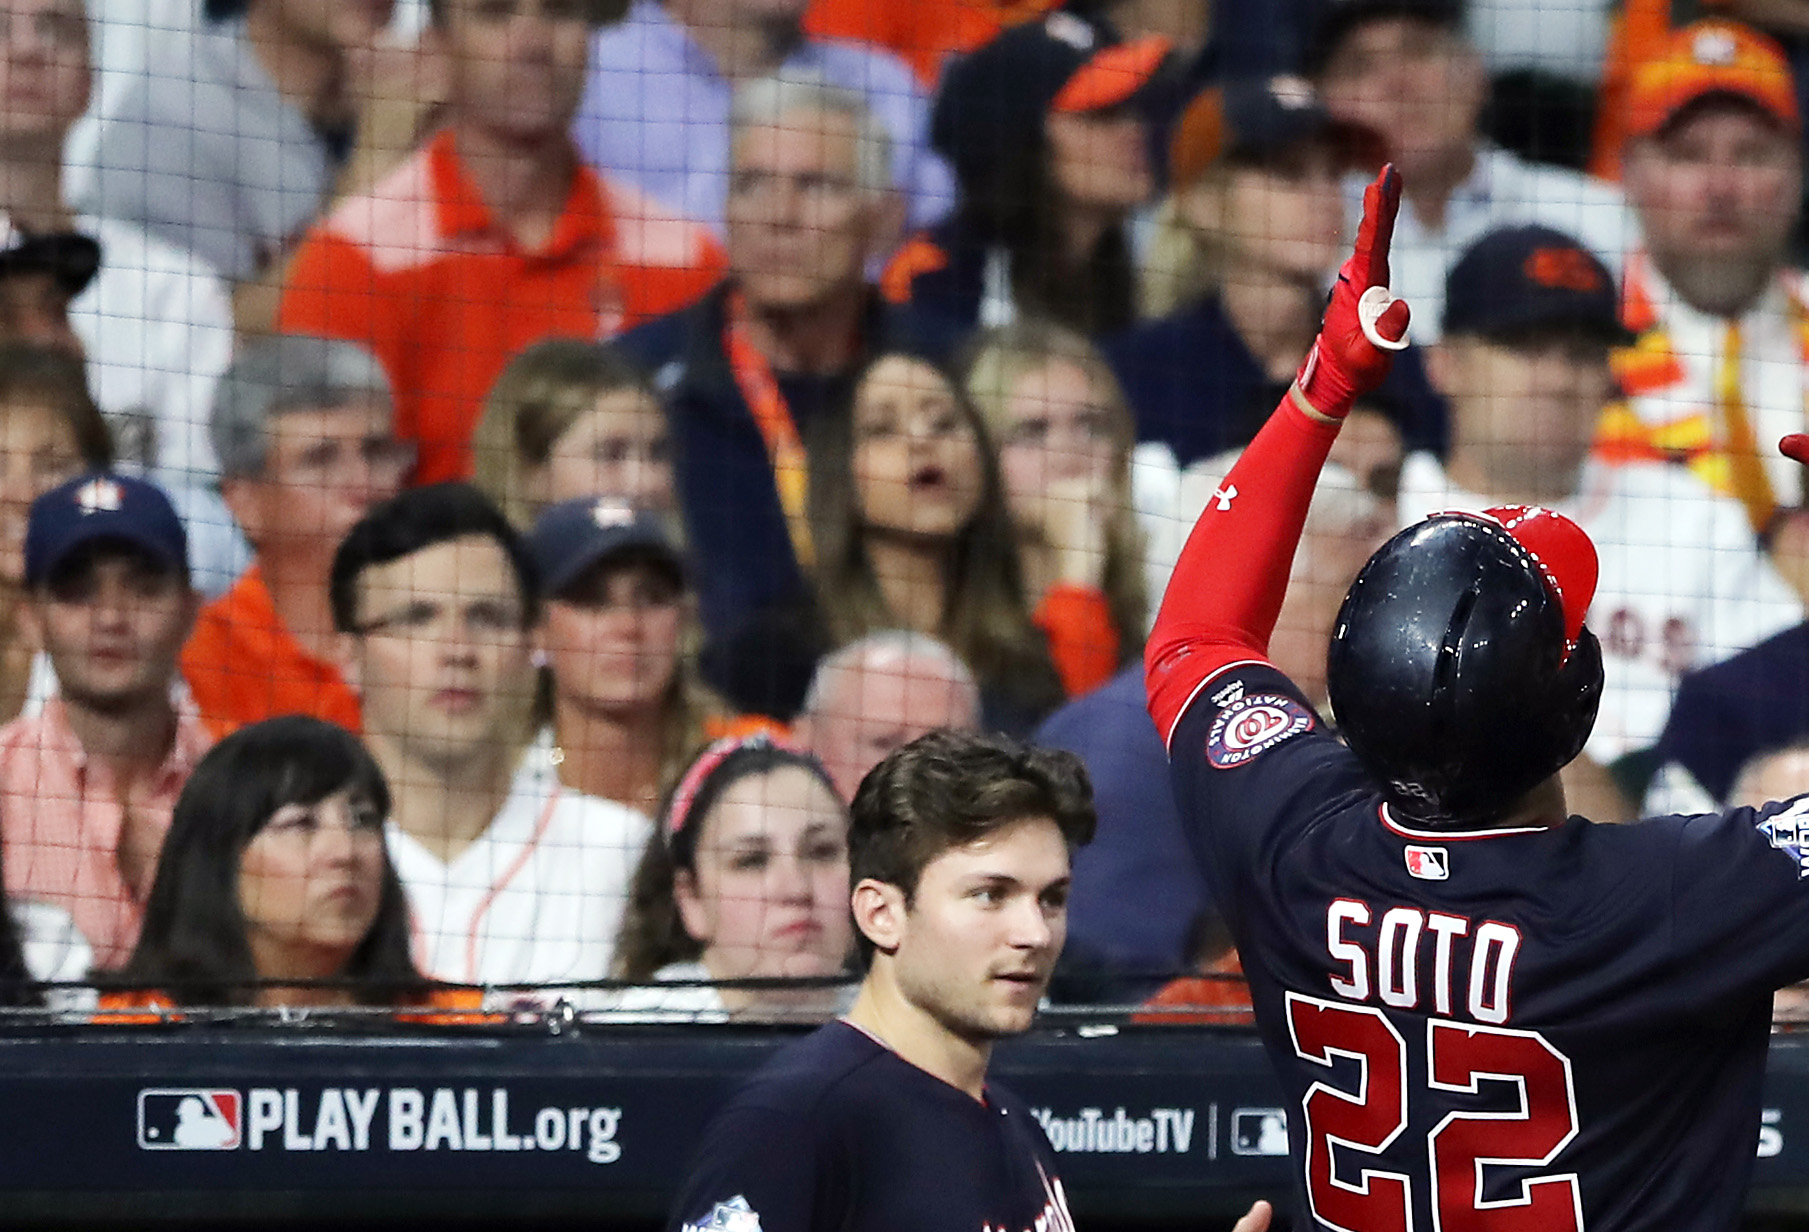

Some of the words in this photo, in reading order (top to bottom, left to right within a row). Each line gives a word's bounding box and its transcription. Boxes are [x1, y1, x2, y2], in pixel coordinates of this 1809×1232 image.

[1326, 897, 1523, 1025] SOTO
[248, 1088, 379, 1150] PLAY
[389, 1088, 622, 1163] BALL.org
